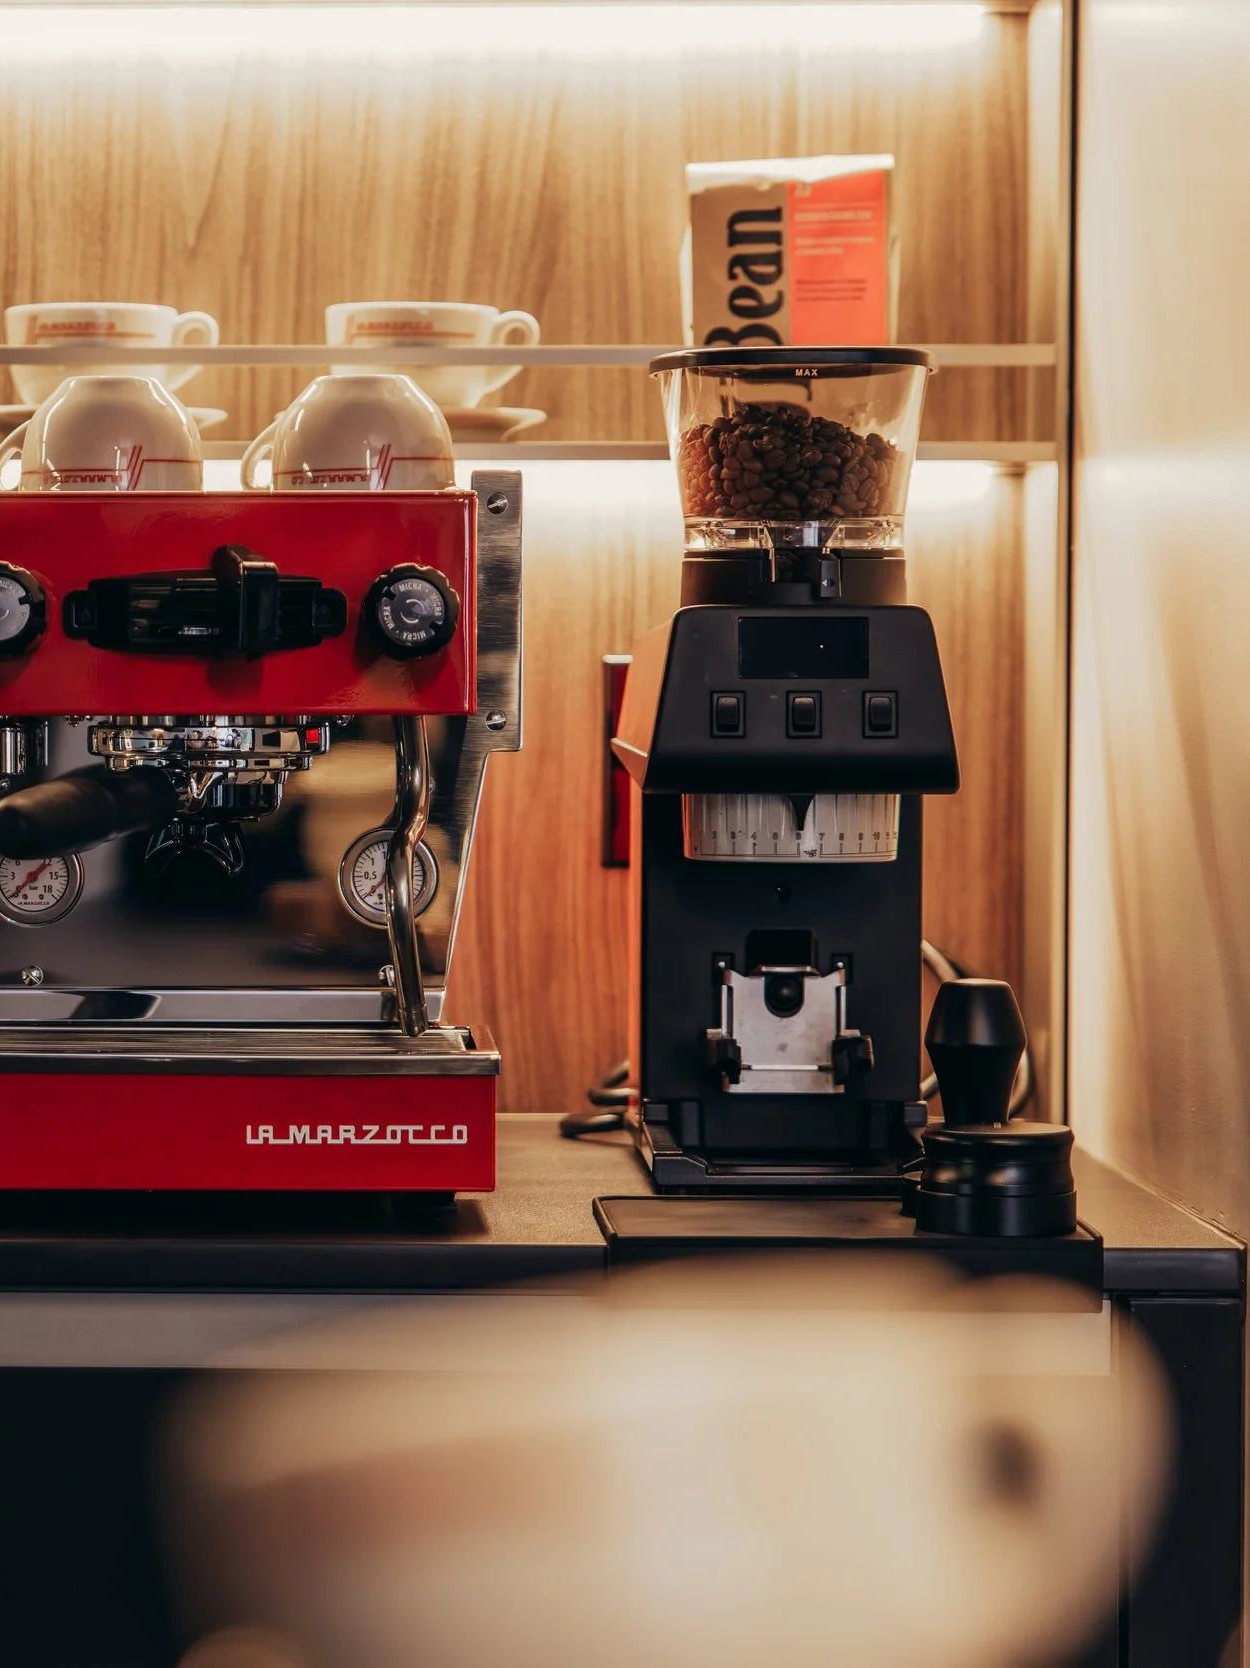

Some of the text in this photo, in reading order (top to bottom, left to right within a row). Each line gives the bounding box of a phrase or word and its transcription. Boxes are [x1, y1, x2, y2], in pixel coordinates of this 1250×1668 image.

[795, 368, 819, 377] MAX
[398, 582, 422, 592] MICRA
[430, 592, 442, 616] MICRA
[383, 606, 396, 630] MICRA
[403, 630, 427, 641] MICRA
[10, 871, 16, 881] 3
[49, 871, 59, 880] 15
[364, 871, 377, 881] 0,5
[43, 884, 53, 894] 18
[246, 1124, 468, 1145] LA MARZOCCO
